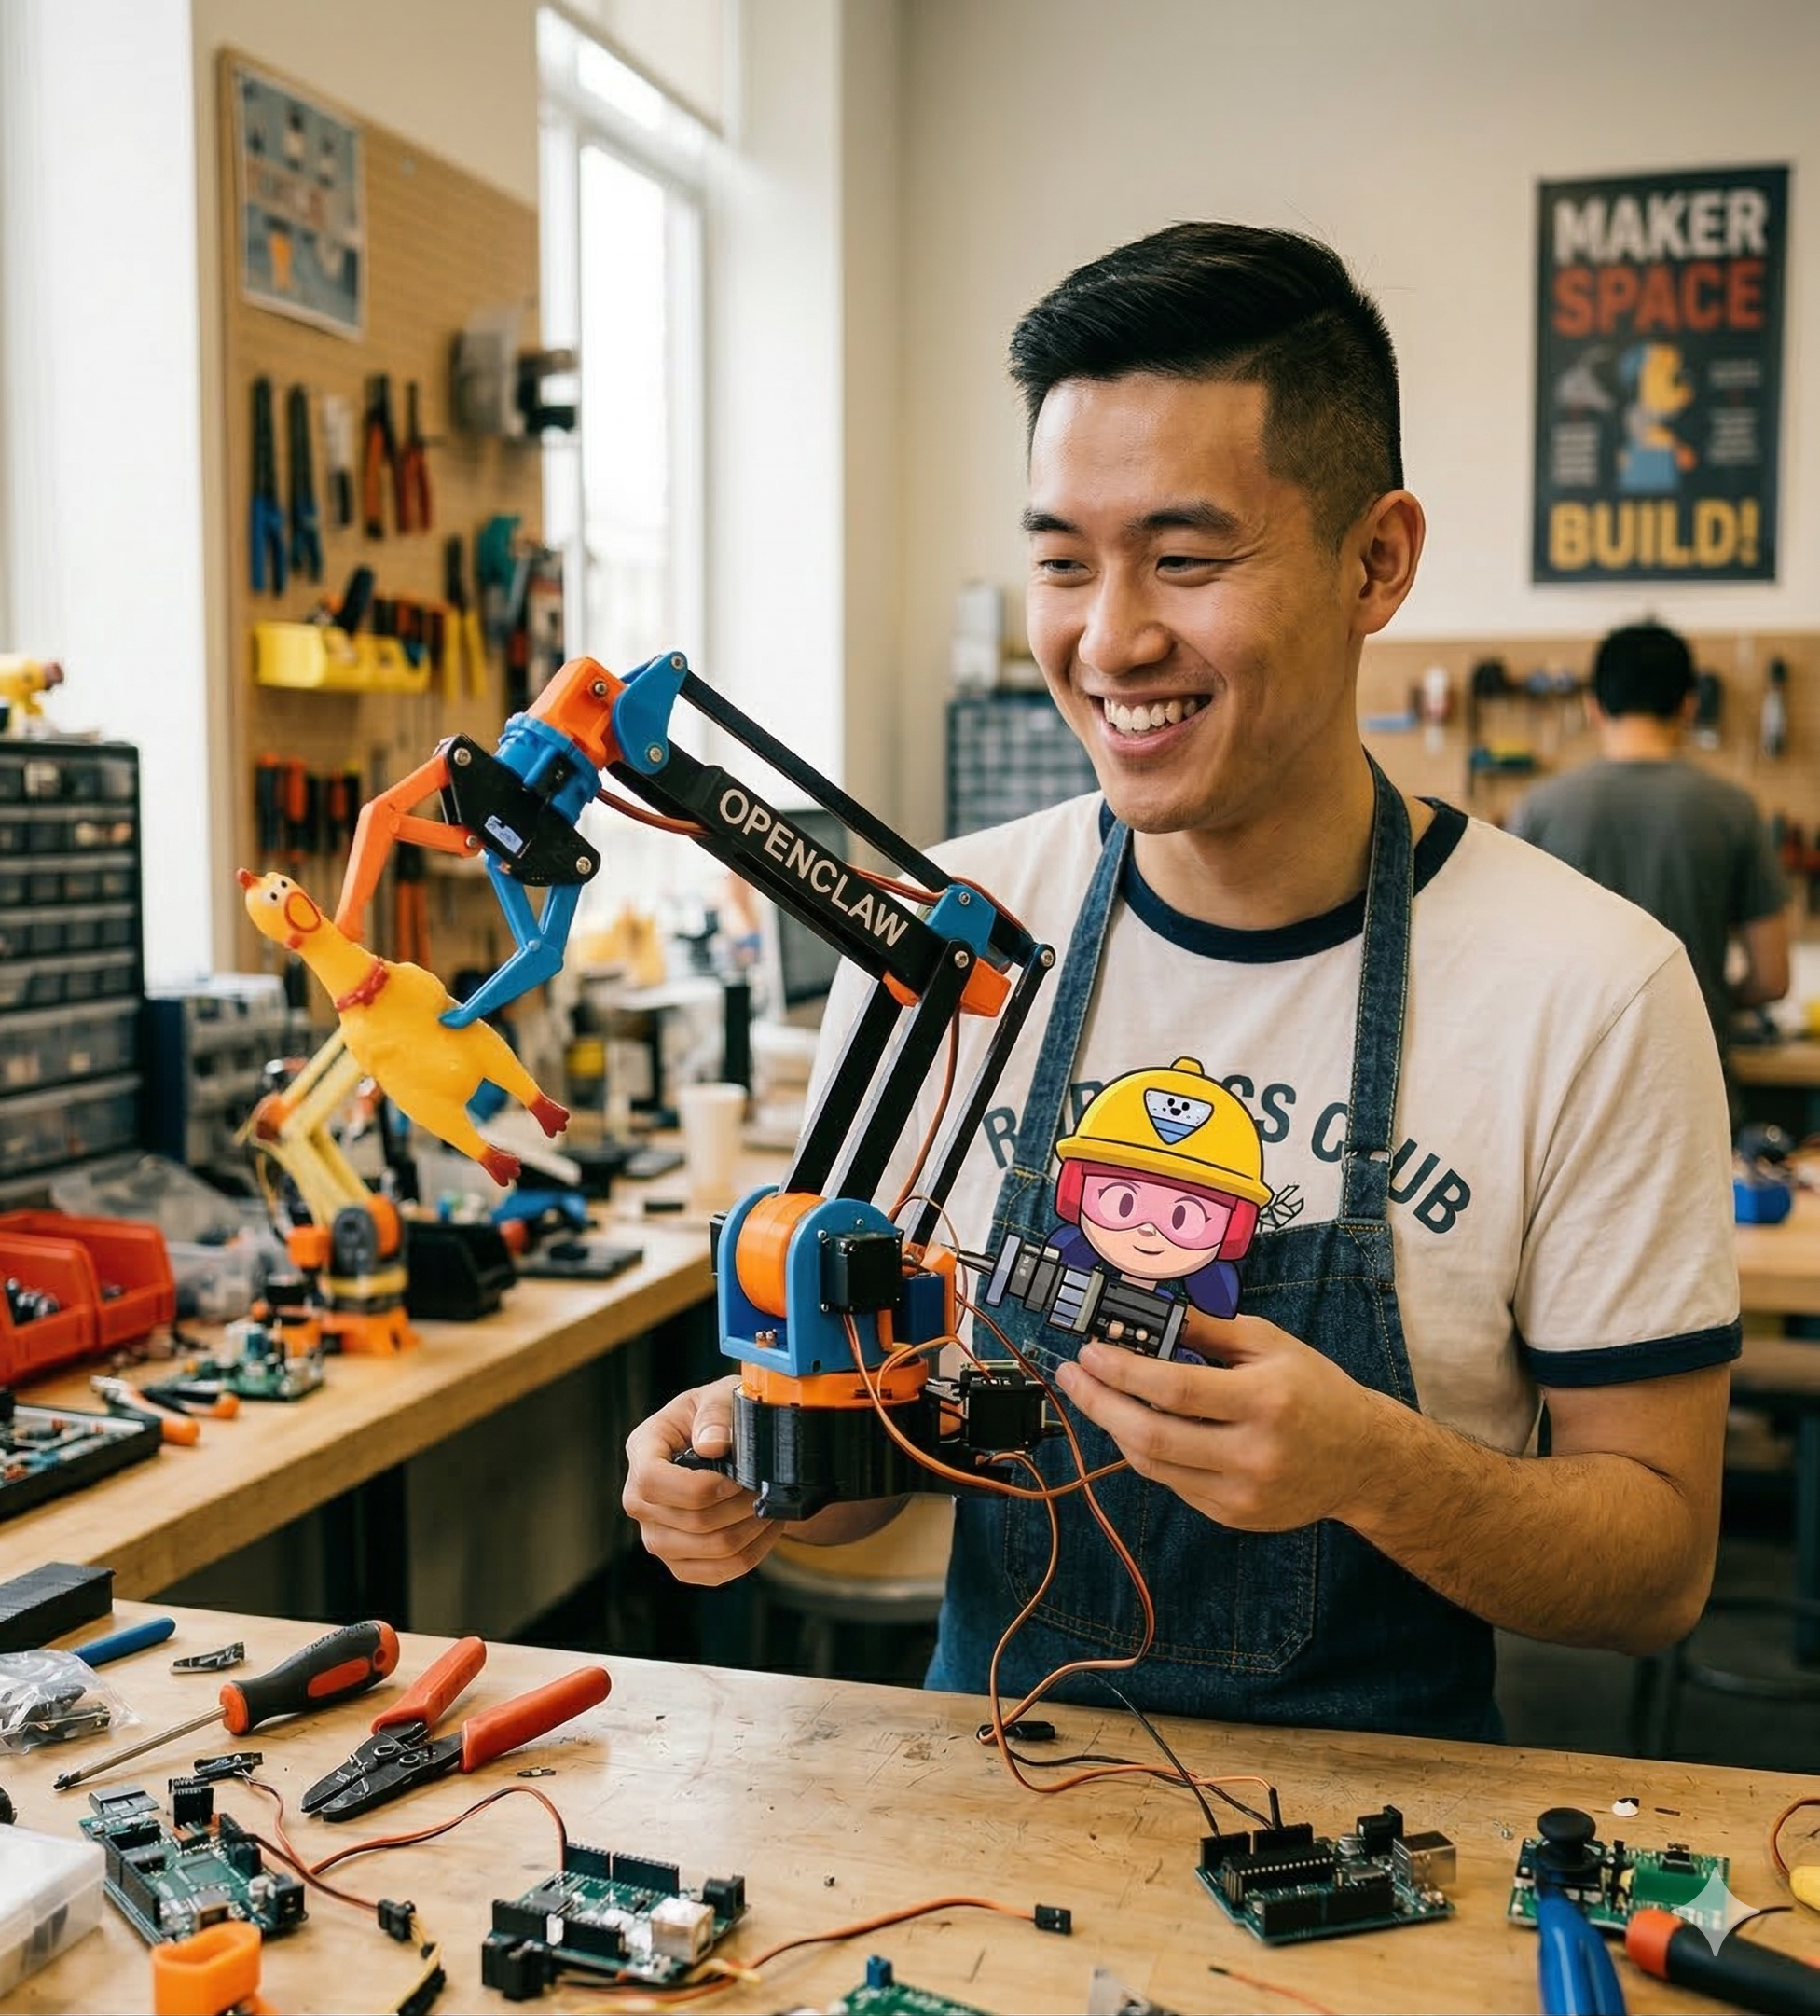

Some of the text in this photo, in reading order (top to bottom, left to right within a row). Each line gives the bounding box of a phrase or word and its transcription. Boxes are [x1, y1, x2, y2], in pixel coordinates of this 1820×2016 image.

[1554, 189, 1769, 267] MAKER
[1553, 258, 1764, 338] SPACE
[1549, 499, 1759, 571] BUILD!
[719, 788, 909, 947] OPENCLAW
[1311, 1102, 1471, 1234] CUB
